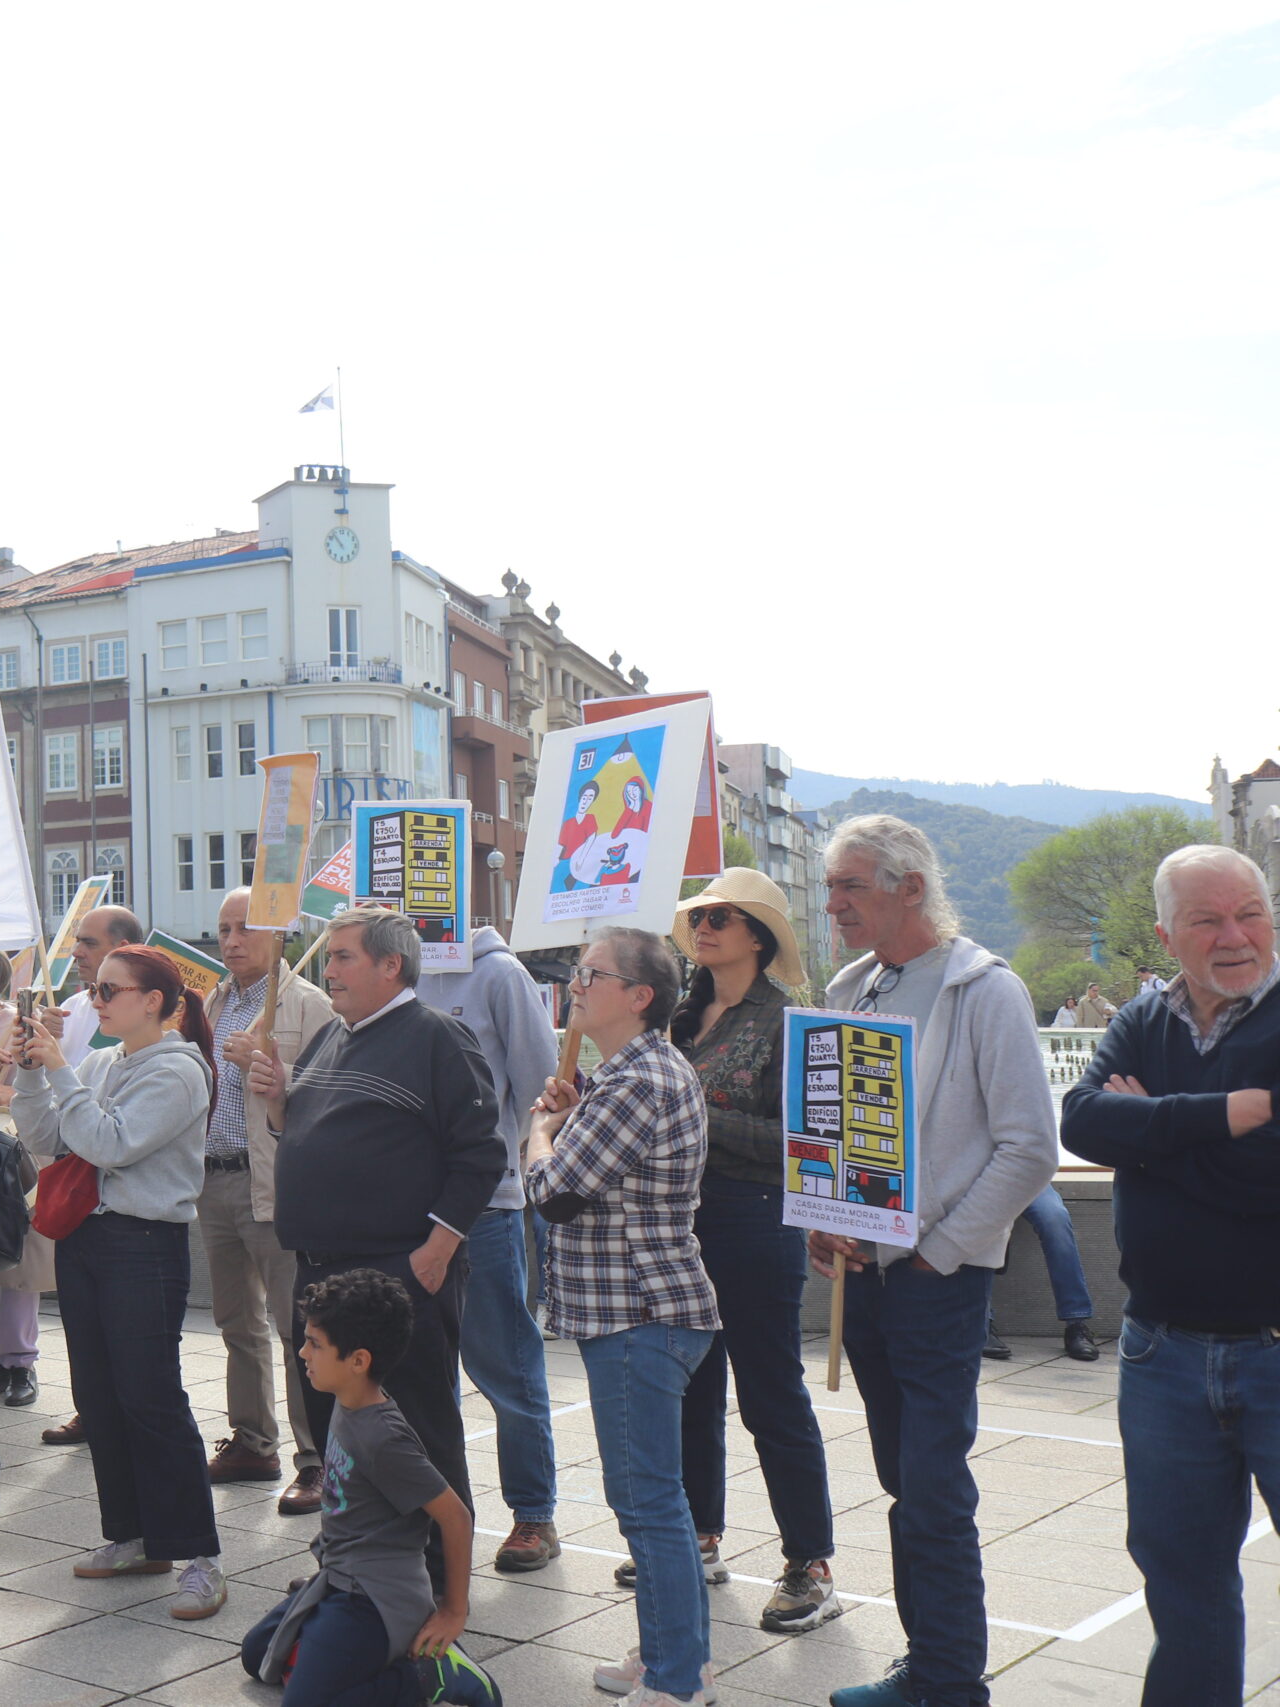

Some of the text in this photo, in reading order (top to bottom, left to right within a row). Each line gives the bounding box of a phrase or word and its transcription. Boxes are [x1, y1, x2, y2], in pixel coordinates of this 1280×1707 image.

[580, 754, 592, 768] 31
[375, 834, 399, 842] QUARTO
[375, 849, 386, 857] T4
[809, 1054, 836, 1062] QUARTO
[855, 1065, 887, 1076] ARRENDA
[809, 1073, 822, 1083] T4
[860, 1094, 884, 1103] VENDE
[791, 1145, 825, 1159] VENDE
[796, 1200, 822, 1210] CASAS
[825, 1206, 846, 1214] PARA
[810, 1213, 830, 1222] PARA
